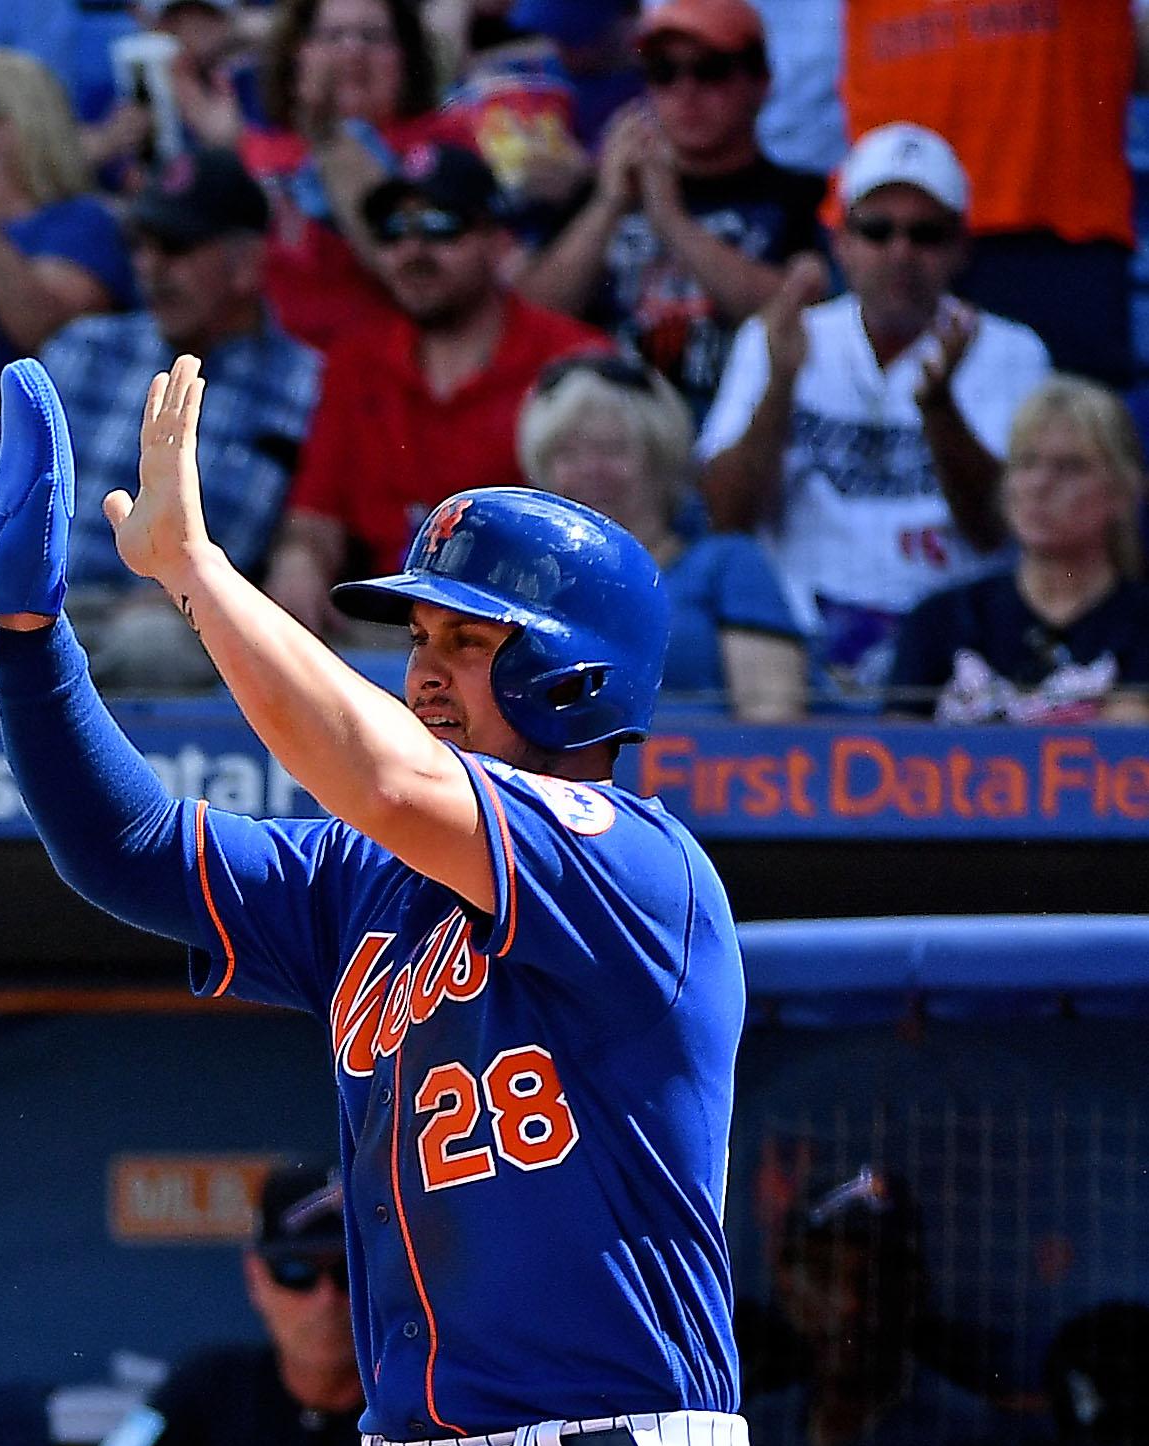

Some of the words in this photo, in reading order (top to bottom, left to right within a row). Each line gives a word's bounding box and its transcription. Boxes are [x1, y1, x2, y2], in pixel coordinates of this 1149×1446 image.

[639, 736, 815, 818] First
[829, 736, 1029, 819] Data
[415, 1044, 580, 1192] 28
